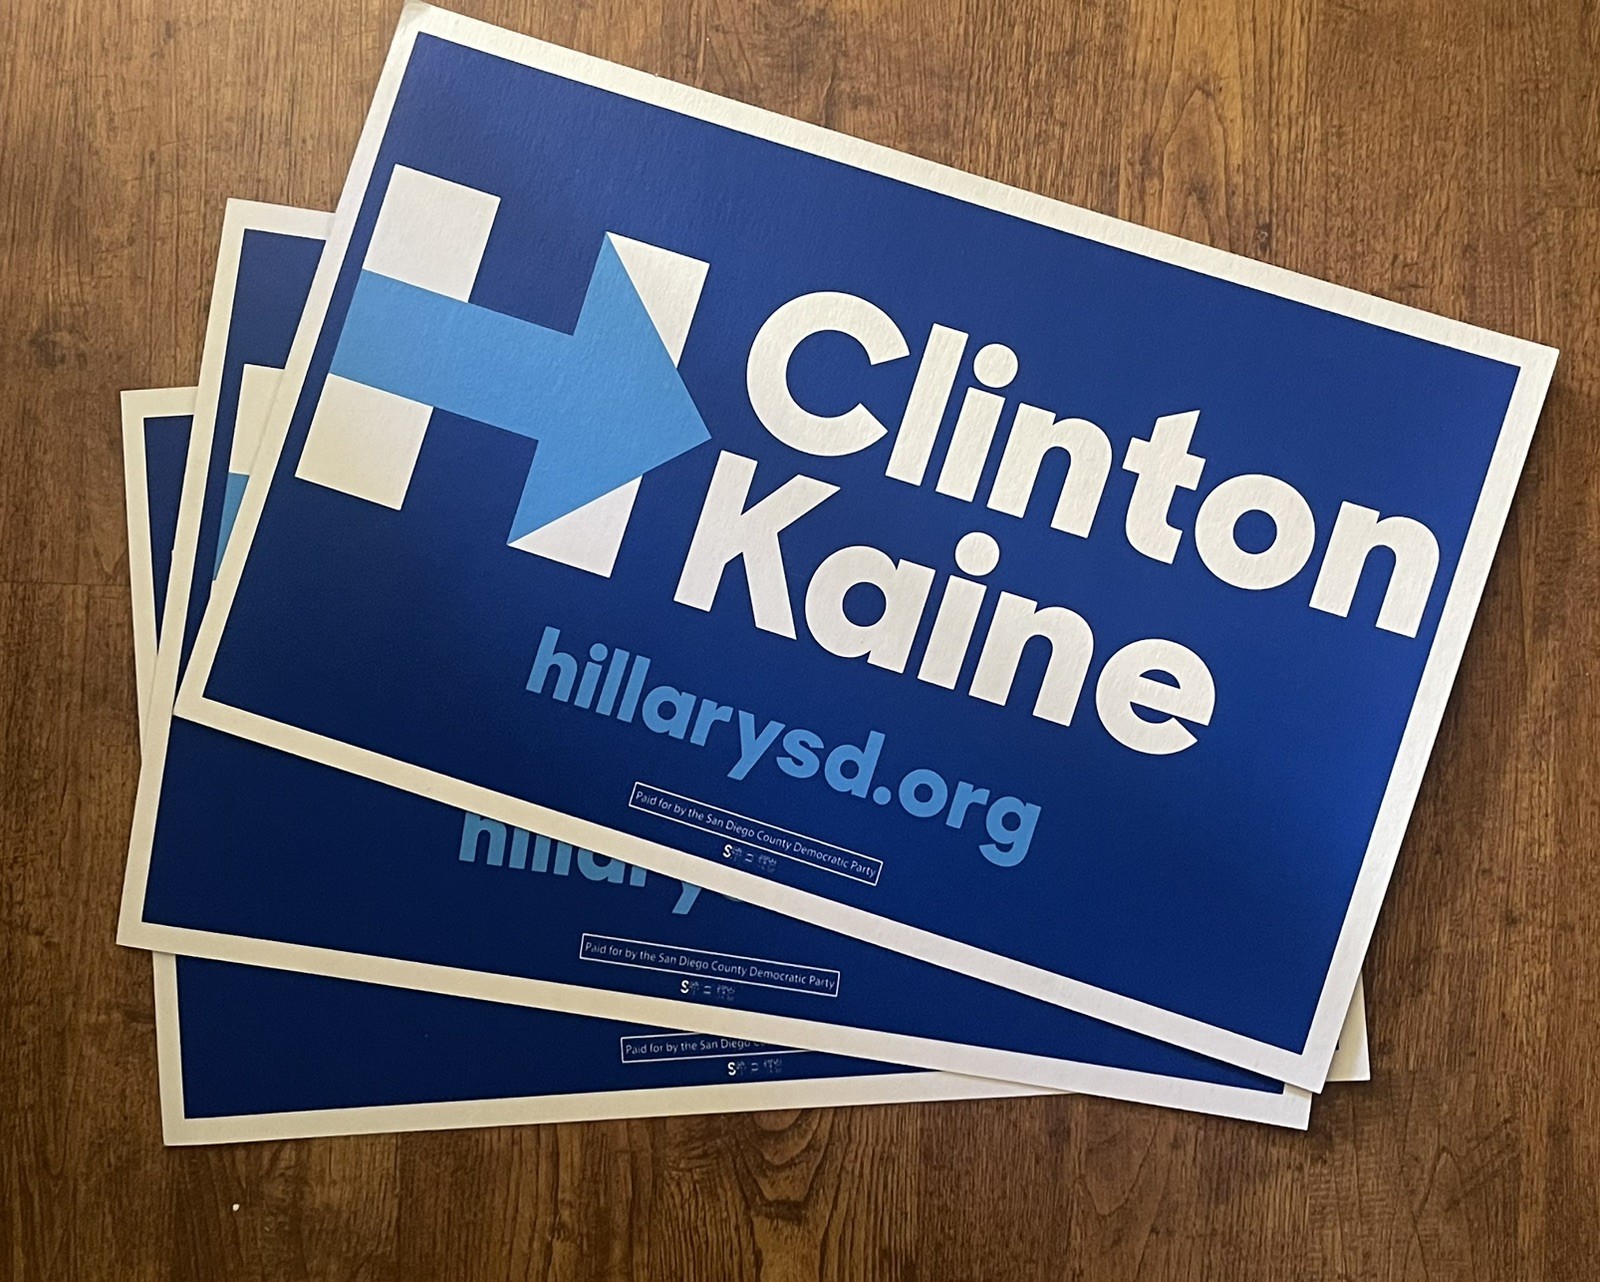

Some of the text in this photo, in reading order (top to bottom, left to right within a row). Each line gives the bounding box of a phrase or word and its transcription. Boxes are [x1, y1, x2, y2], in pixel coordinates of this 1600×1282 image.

[746, 291, 1441, 638] Clinton
[673, 450, 1217, 756] Kaine
[525, 626, 1042, 868] hillarysd.org
[636, 791, 657, 805] Paid
[658, 798, 672, 810] for
[674, 804, 687, 816] by
[687, 809, 704, 821] the
[706, 814, 724, 828] San
[725, 820, 755, 838] Diego
[756, 830, 792, 851] County
[793, 842, 849, 868] Democratic
[850, 860, 877, 878] Party
[585, 942, 835, 990] Paid for by the San Diego County Democratic Party
[625, 1044, 647, 1055] Paid
[650, 1043, 663, 1053] for
[666, 1042, 679, 1054] by
[681, 1042, 698, 1051] the
[700, 1040, 718, 1051] San
